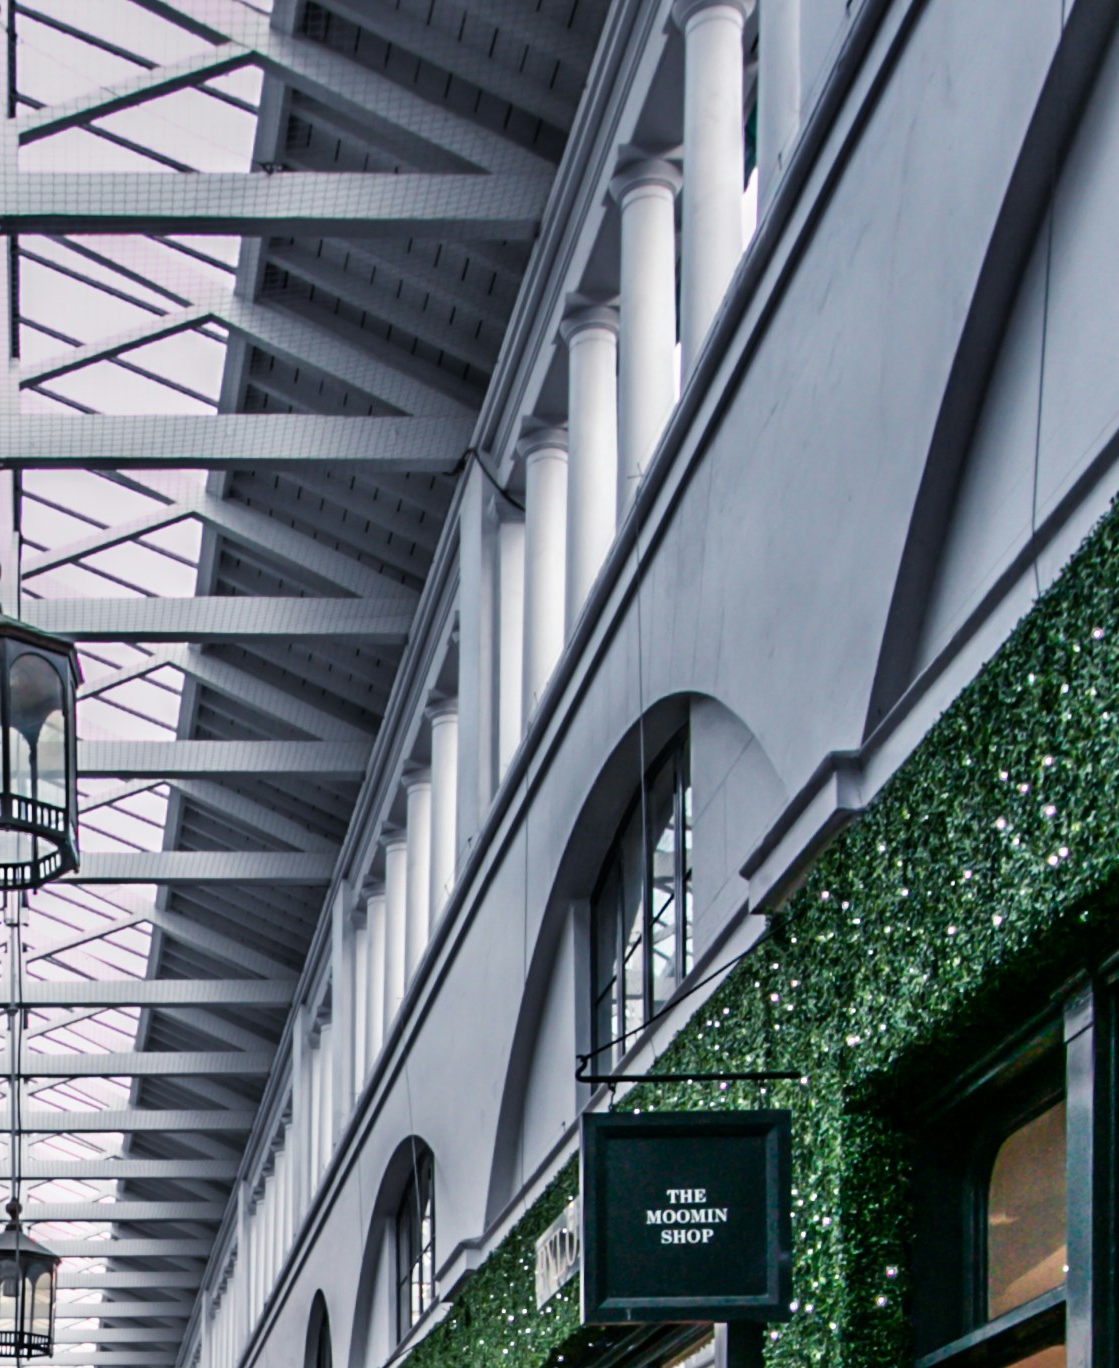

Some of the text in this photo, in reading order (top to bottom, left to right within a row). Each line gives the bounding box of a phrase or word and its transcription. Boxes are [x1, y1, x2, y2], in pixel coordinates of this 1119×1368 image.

[666, 1188, 707, 1204] THE
[646, 1207, 728, 1225] MOOMIN
[661, 1229, 714, 1244] SHOP
